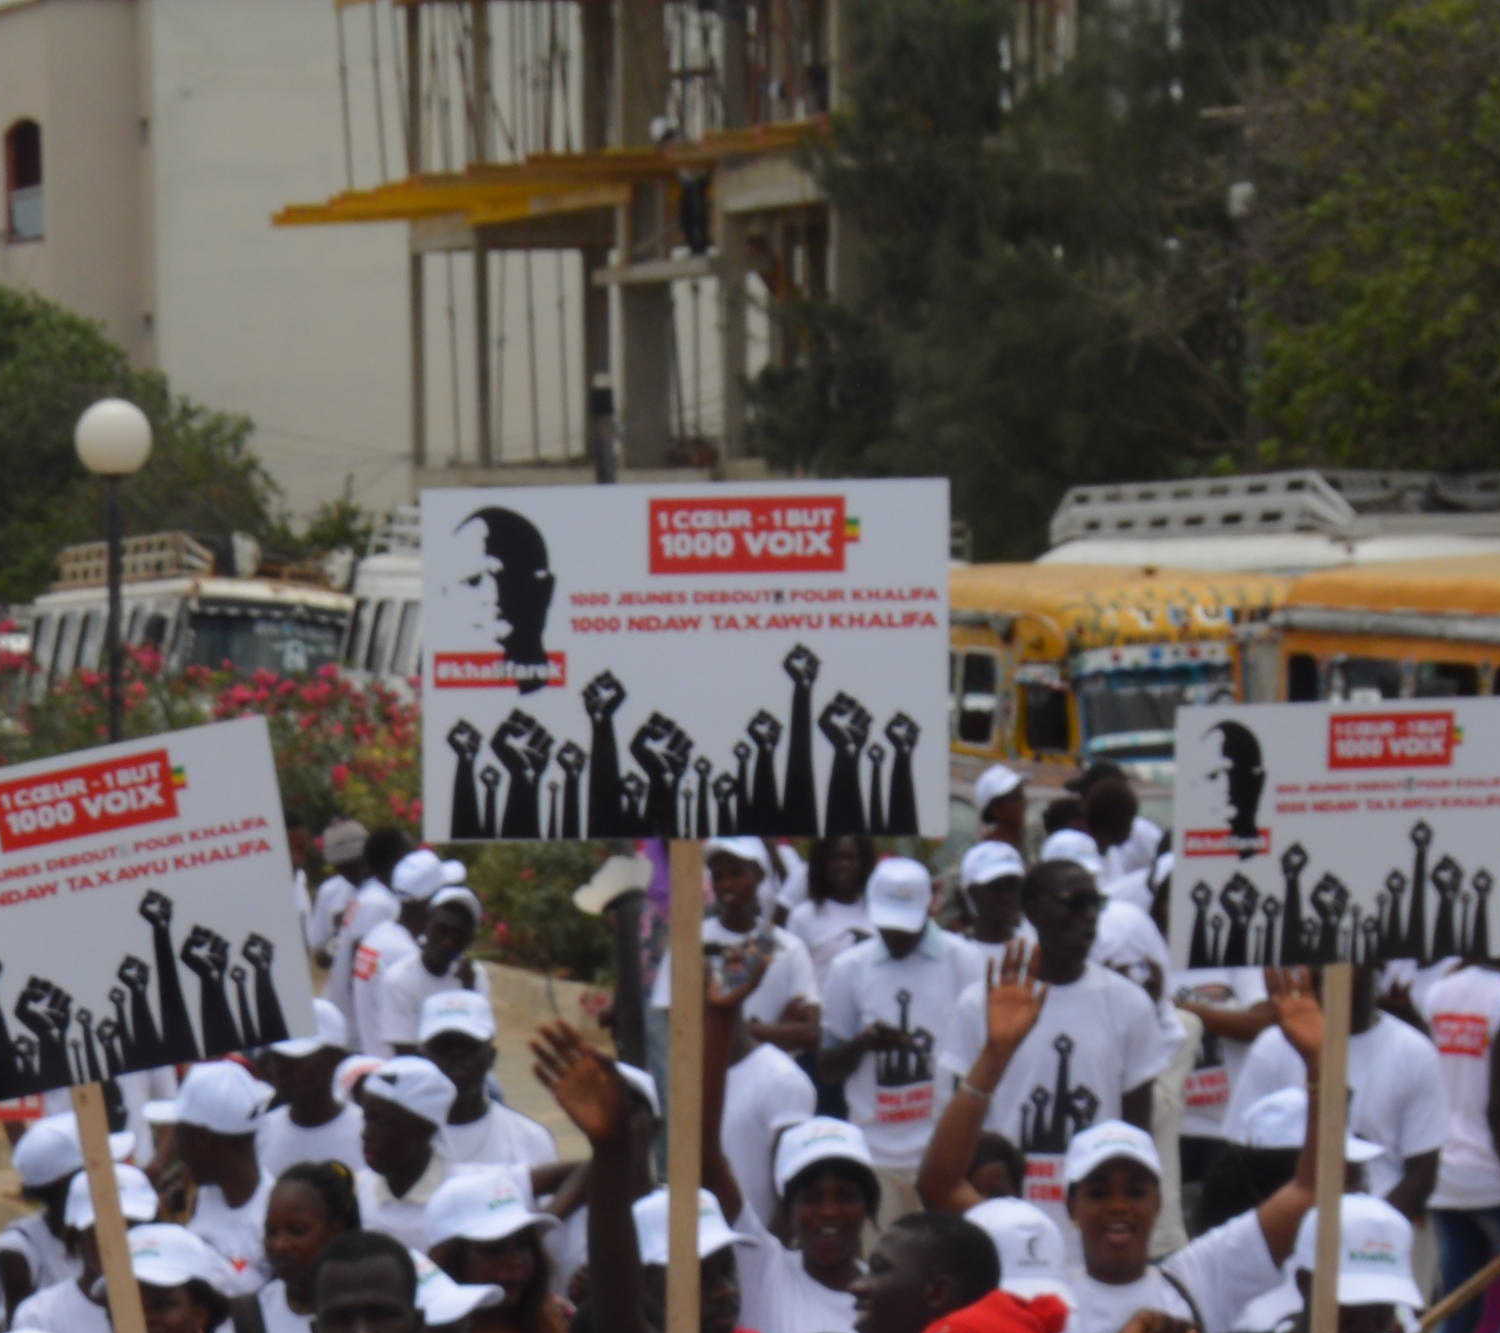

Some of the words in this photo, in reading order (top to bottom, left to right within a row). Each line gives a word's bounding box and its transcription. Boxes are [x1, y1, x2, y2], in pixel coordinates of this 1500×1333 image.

[787, 509, 835, 526] BUT
[659, 533, 735, 557] 1000
[745, 531, 833, 555] VOIX
[570, 594, 610, 605] 1000
[617, 593, 686, 605] JEUNES
[790, 589, 846, 601] POUR
[852, 588, 938, 601] KHALIFA
[570, 617, 621, 633] 1000
[628, 615, 703, 632] NDAW
[712, 614, 824, 631] TAXAWU
[829, 612, 938, 628] KHALIFA
[1388, 736, 1447, 756] VOIX
[5, 802, 75, 838] 1000
[81, 783, 166, 819] VOIX
[133, 835, 186, 854] POUR
[190, 817, 270, 842] KHALIFA
[68, 859, 170, 894] TAXAWU
[173, 839, 274, 872] KHALIFA
